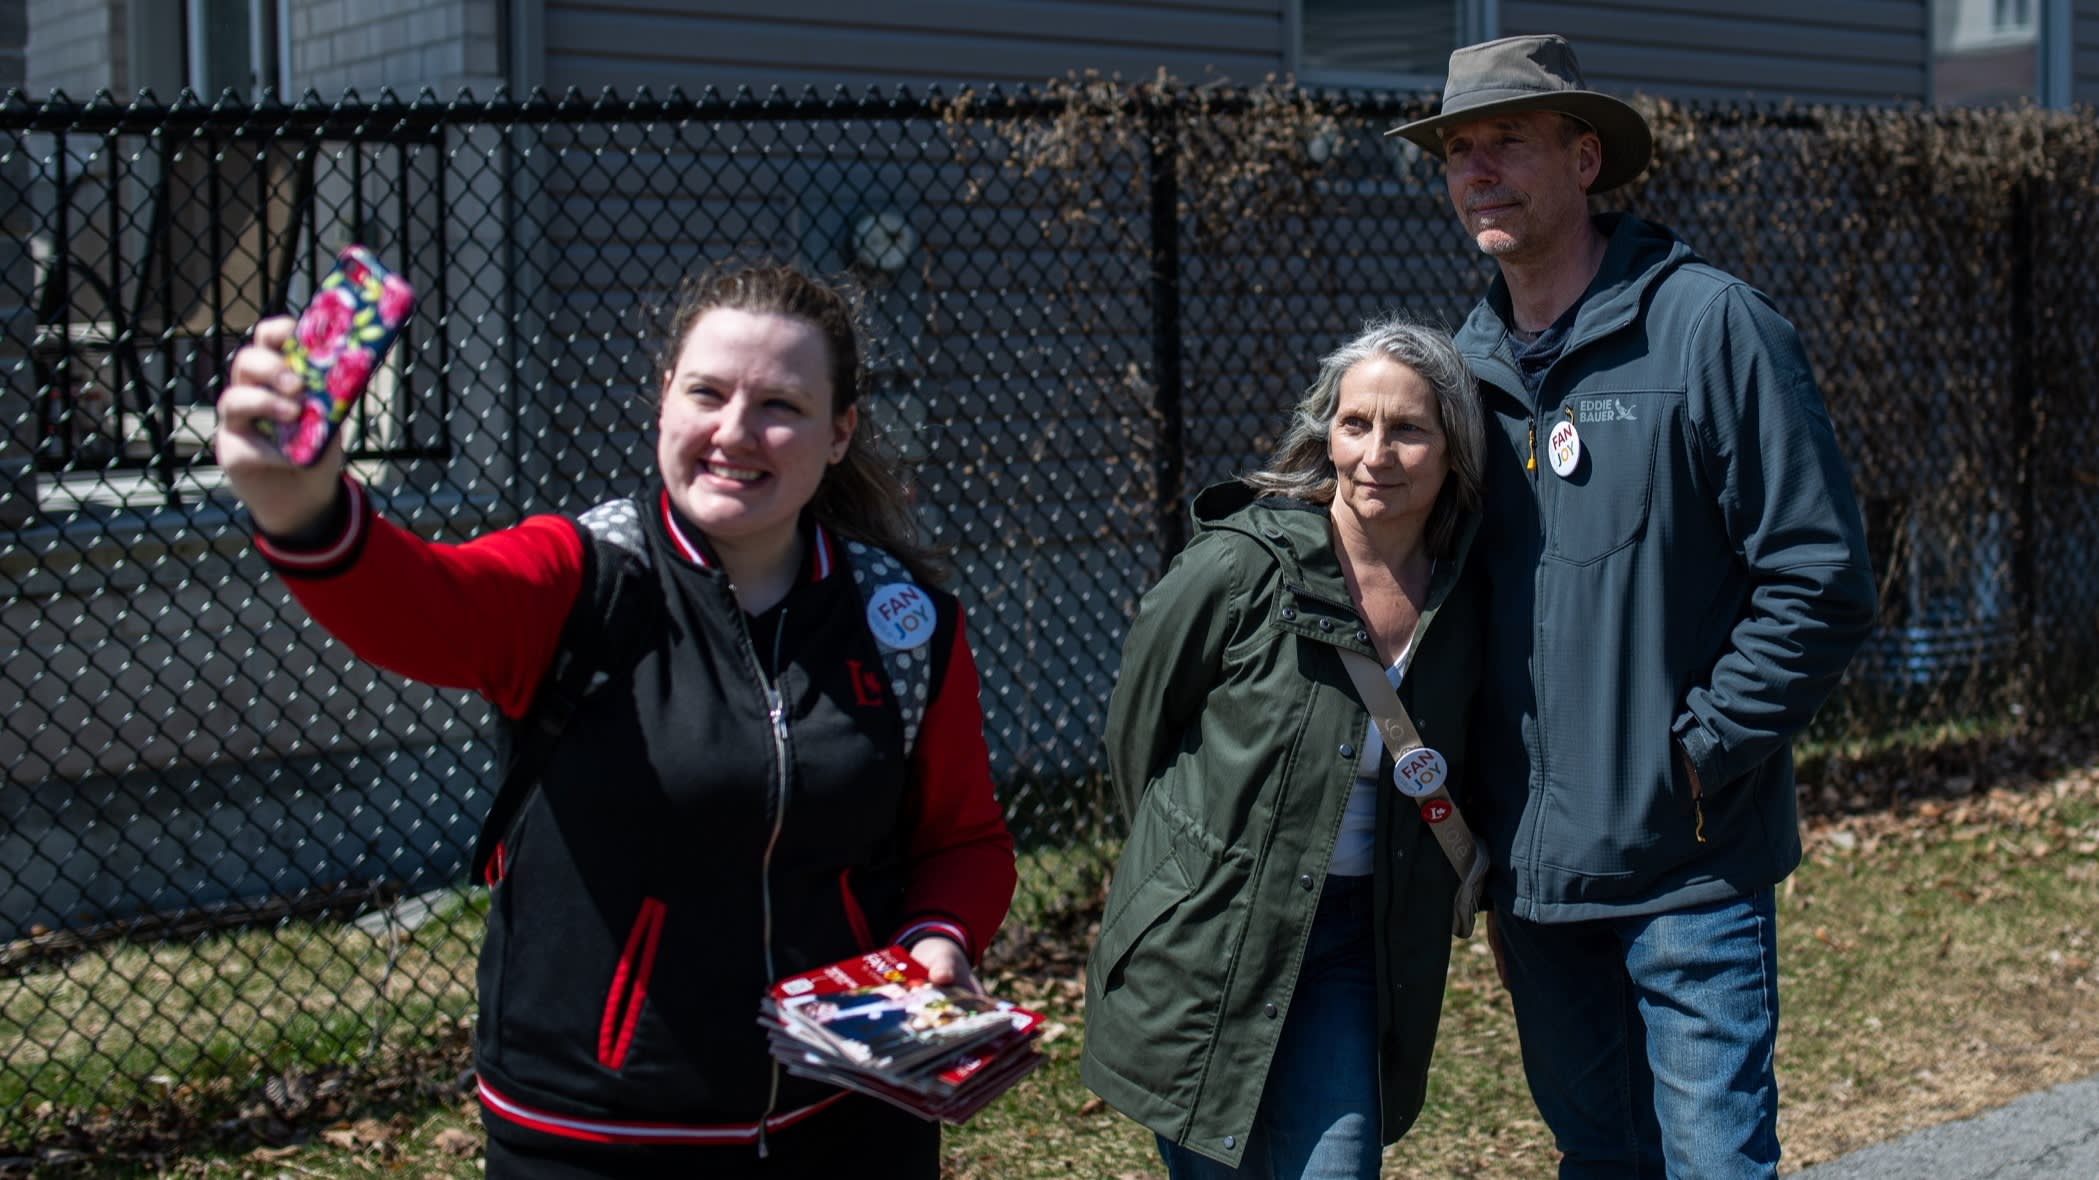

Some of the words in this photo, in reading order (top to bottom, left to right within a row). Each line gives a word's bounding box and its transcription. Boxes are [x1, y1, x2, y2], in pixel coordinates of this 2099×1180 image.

[1580, 399, 1612, 411] EDDIE
[1580, 410, 1615, 423] BAUER
[1552, 424, 1573, 451] FAN
[1557, 441, 1574, 467] JOY
[877, 585, 920, 621] FAN
[894, 604, 929, 641] JOY
[1401, 750, 1434, 779] FAN
[1414, 762, 1442, 791] JOY
